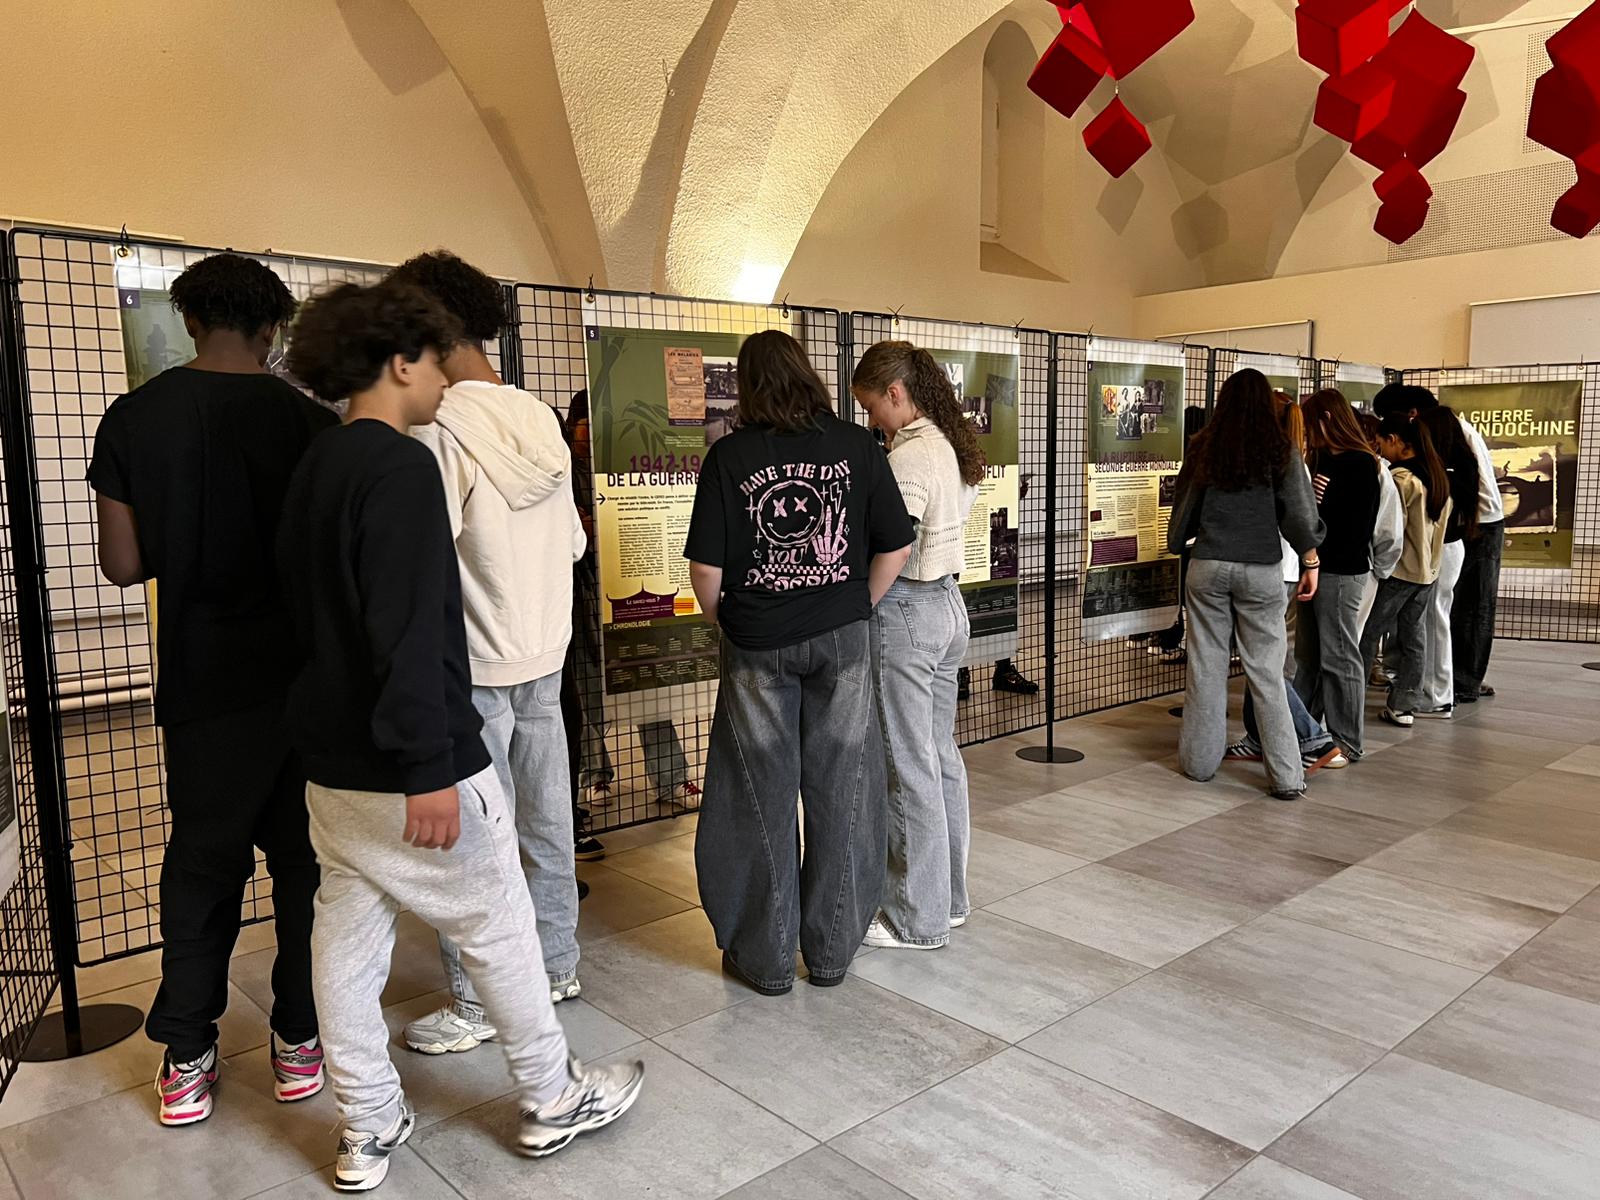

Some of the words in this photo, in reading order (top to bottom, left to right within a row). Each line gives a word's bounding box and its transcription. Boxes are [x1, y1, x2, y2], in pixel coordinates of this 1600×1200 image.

[126, 295, 133, 305] 6
[589, 329, 595, 338] 5
[1459, 411, 1466, 422] A
[1470, 409, 1534, 423] GUERRE
[1473, 420, 1575, 437] INDOCHINE
[629, 452, 701, 474] 1947-19
[1095, 462, 1124, 473] SECONDE
[1125, 461, 1149, 472] GUERRE
[1150, 460, 1179, 471] MONDIALE
[607, 472, 625, 487] DE
[629, 472, 646, 487] LA
[740, 465, 779, 496] HAVE
[782, 463, 816, 479] THE
[820, 460, 851, 480] DAY
[768, 548, 804, 565] YOU
